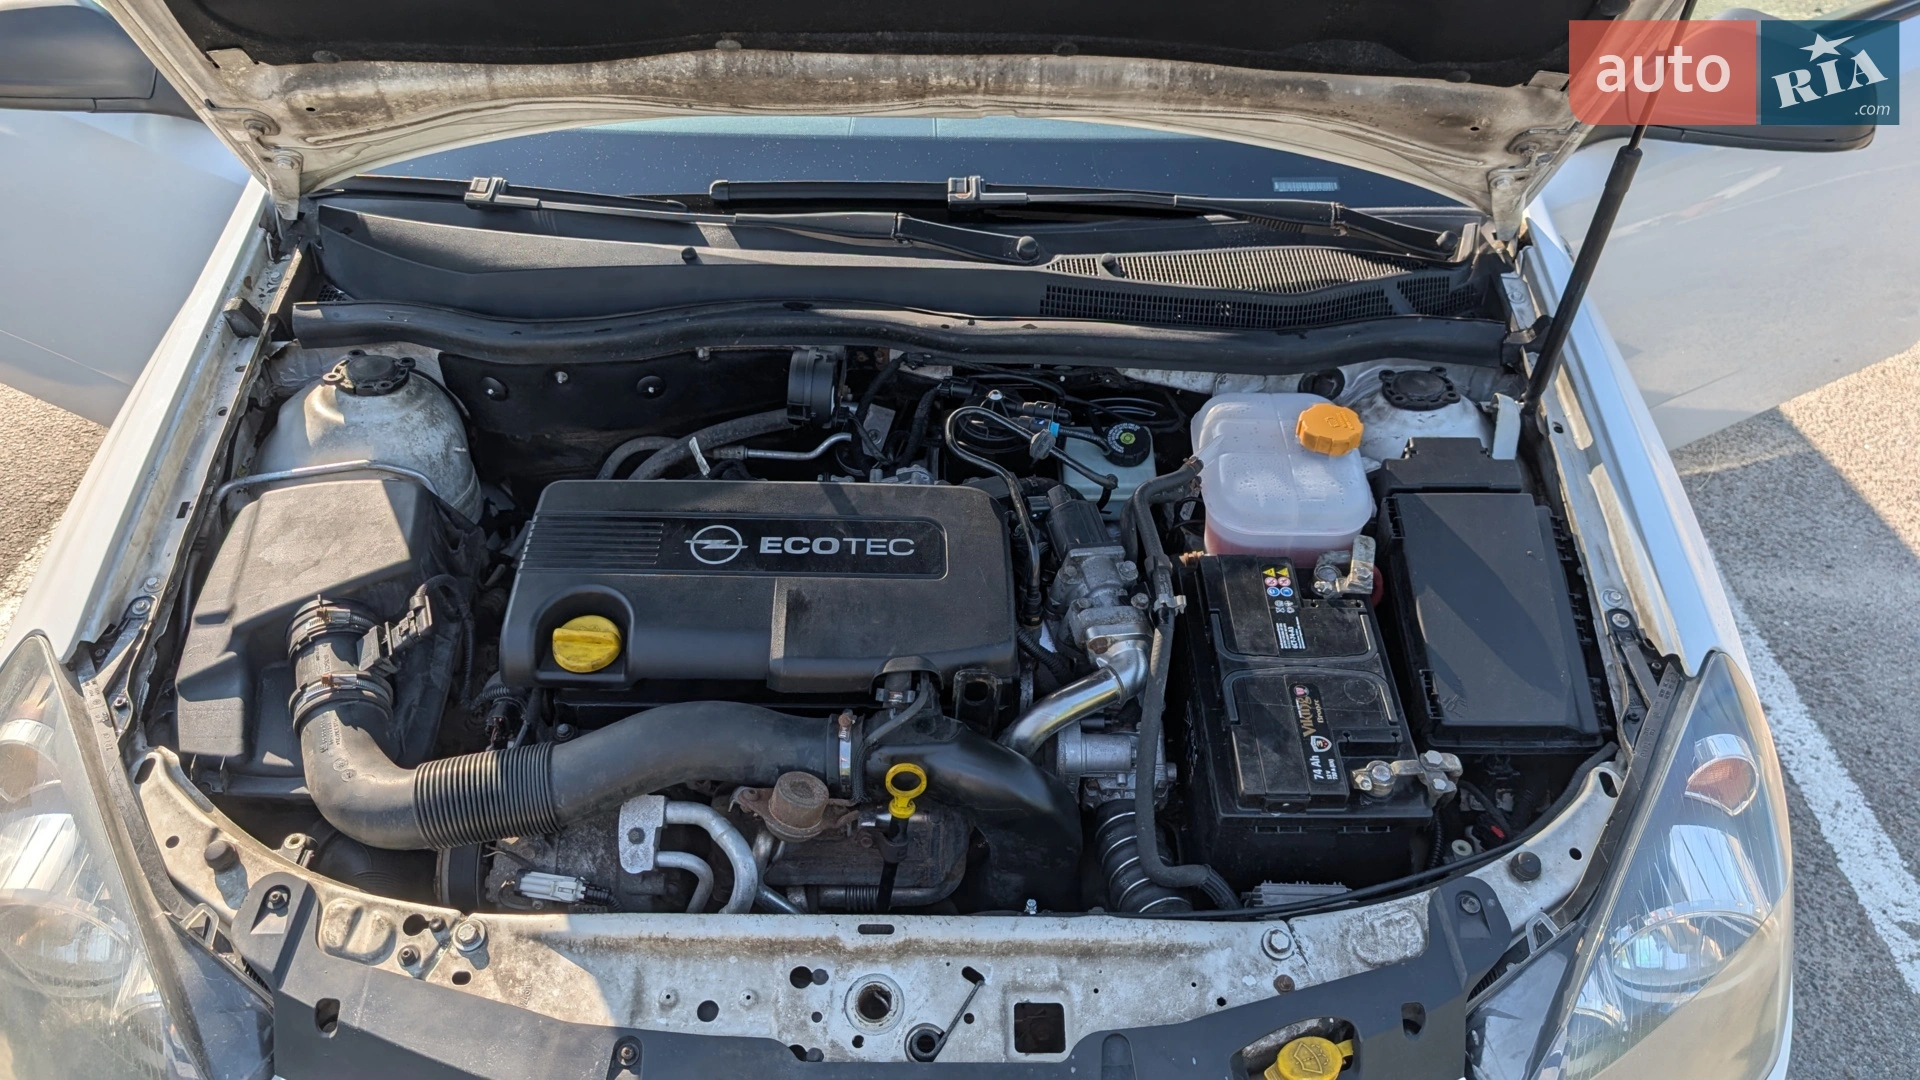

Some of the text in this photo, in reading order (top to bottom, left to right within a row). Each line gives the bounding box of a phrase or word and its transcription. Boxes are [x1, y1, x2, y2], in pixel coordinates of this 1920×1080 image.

[759, 536, 916, 556] ECOTEC
[1296, 696, 1317, 737] Viking
[1309, 755, 1324, 780] 74 Ah
